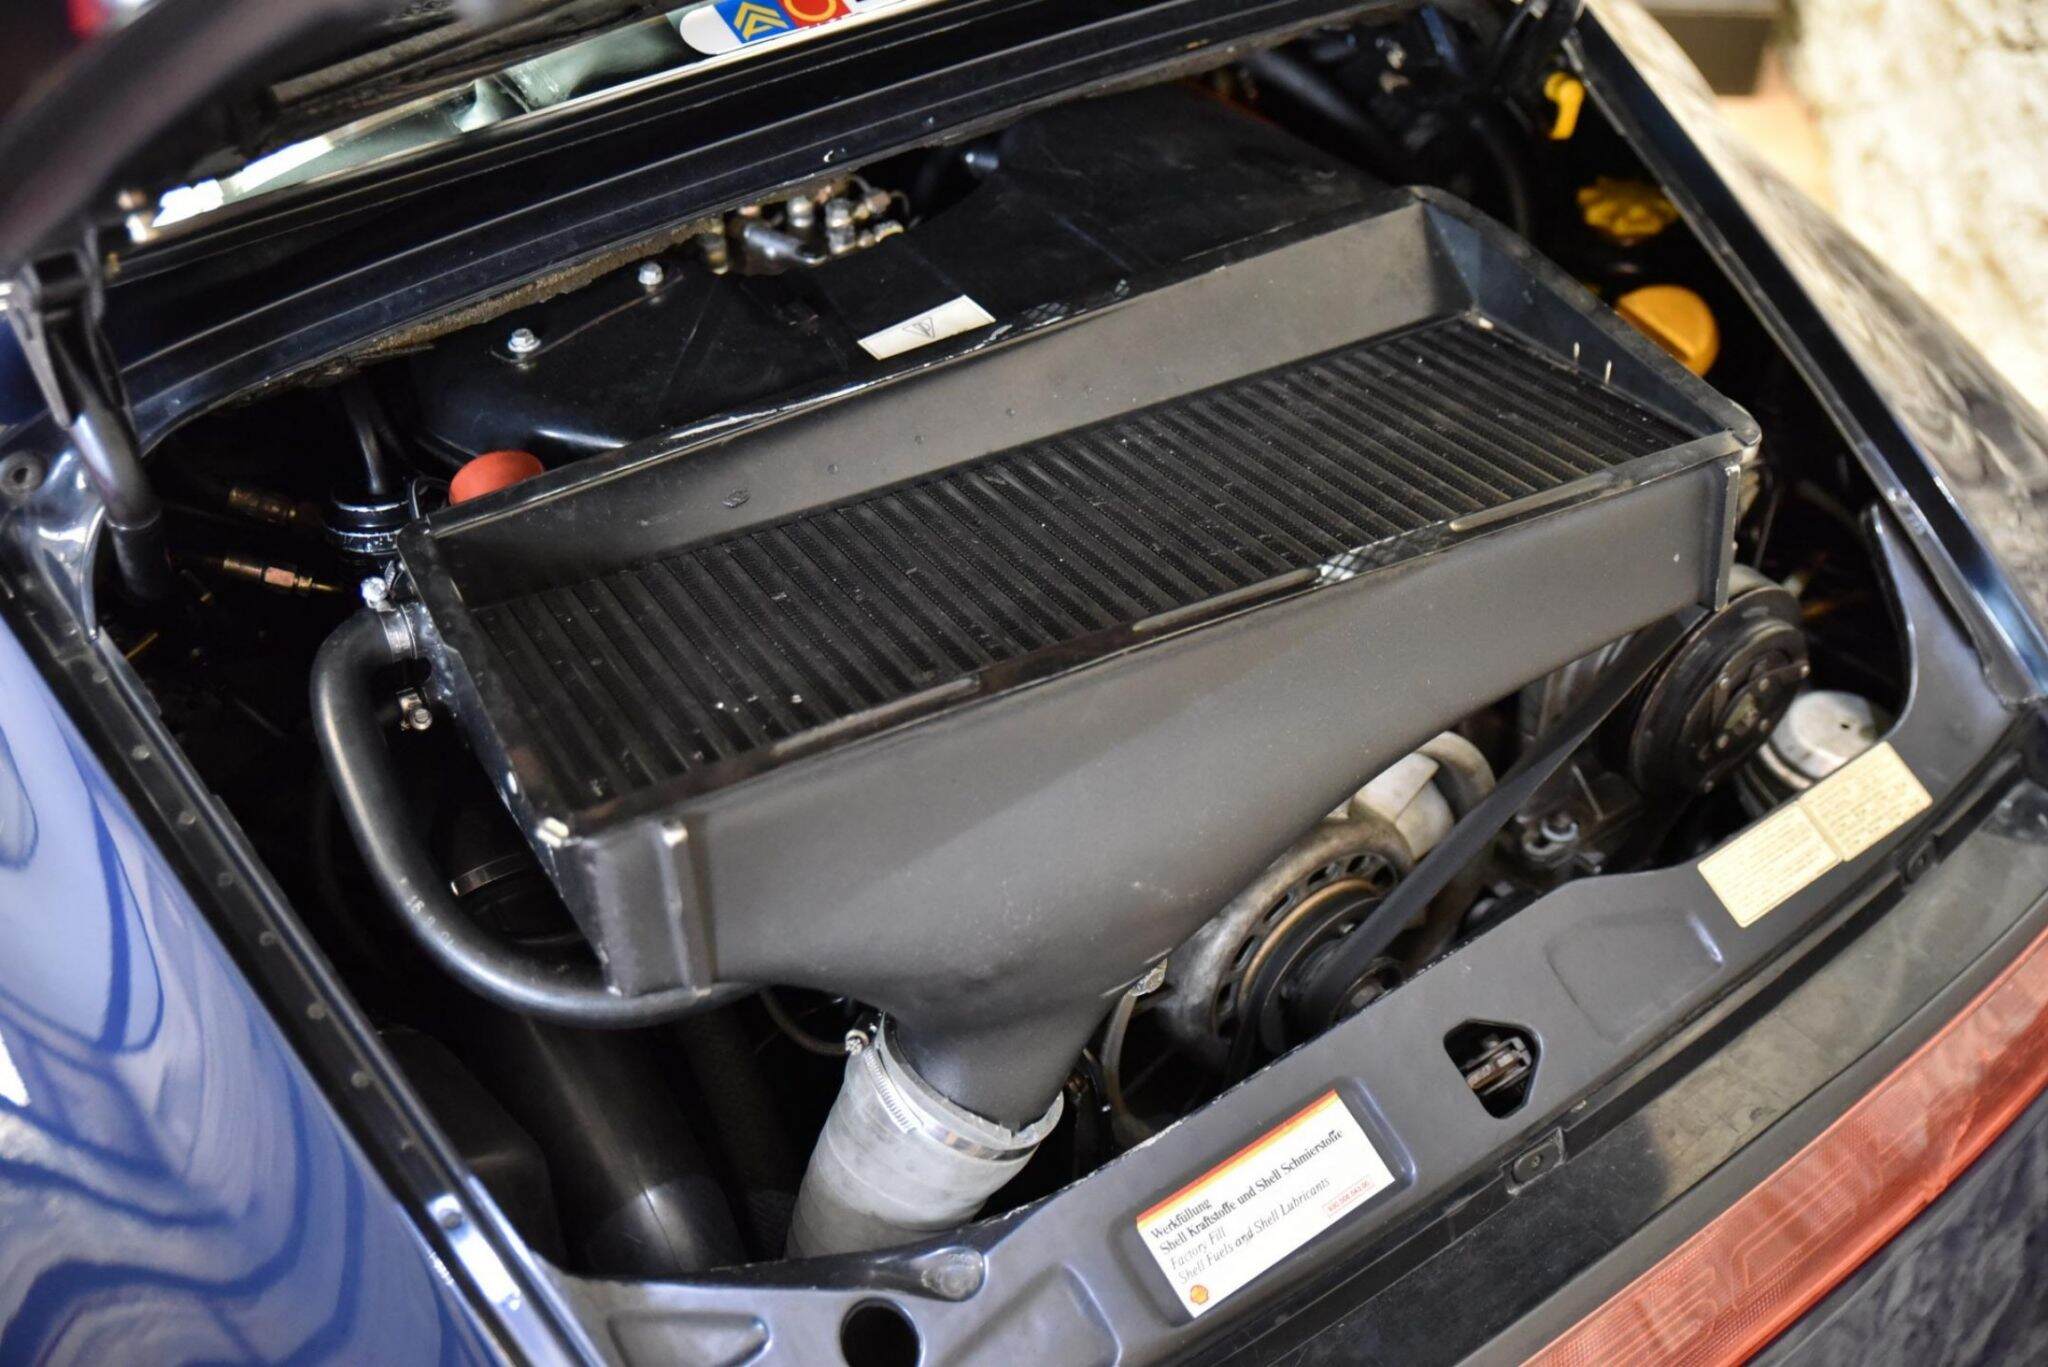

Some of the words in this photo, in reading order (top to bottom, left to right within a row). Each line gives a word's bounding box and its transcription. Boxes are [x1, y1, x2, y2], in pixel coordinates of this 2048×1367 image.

[1150, 1198, 1212, 1240] Werkfüllung
[1159, 1228, 1188, 1255] Shell
[1188, 1201, 1237, 1238] Kraftstoffe
[1238, 1184, 1257, 1206] und
[1256, 1169, 1282, 1193] Shell
[1281, 1129, 1344, 1176] Schmierstoffe
[1169, 1239, 1208, 1270] Factory
[1208, 1227, 1227, 1247] Fill
[1178, 1258, 1206, 1284] Shell
[1206, 1243, 1234, 1266] Fuels
[1234, 1228, 1255, 1251] and
[1255, 1210, 1281, 1237] Shell
[1280, 1178, 1332, 1216] Lubricants
